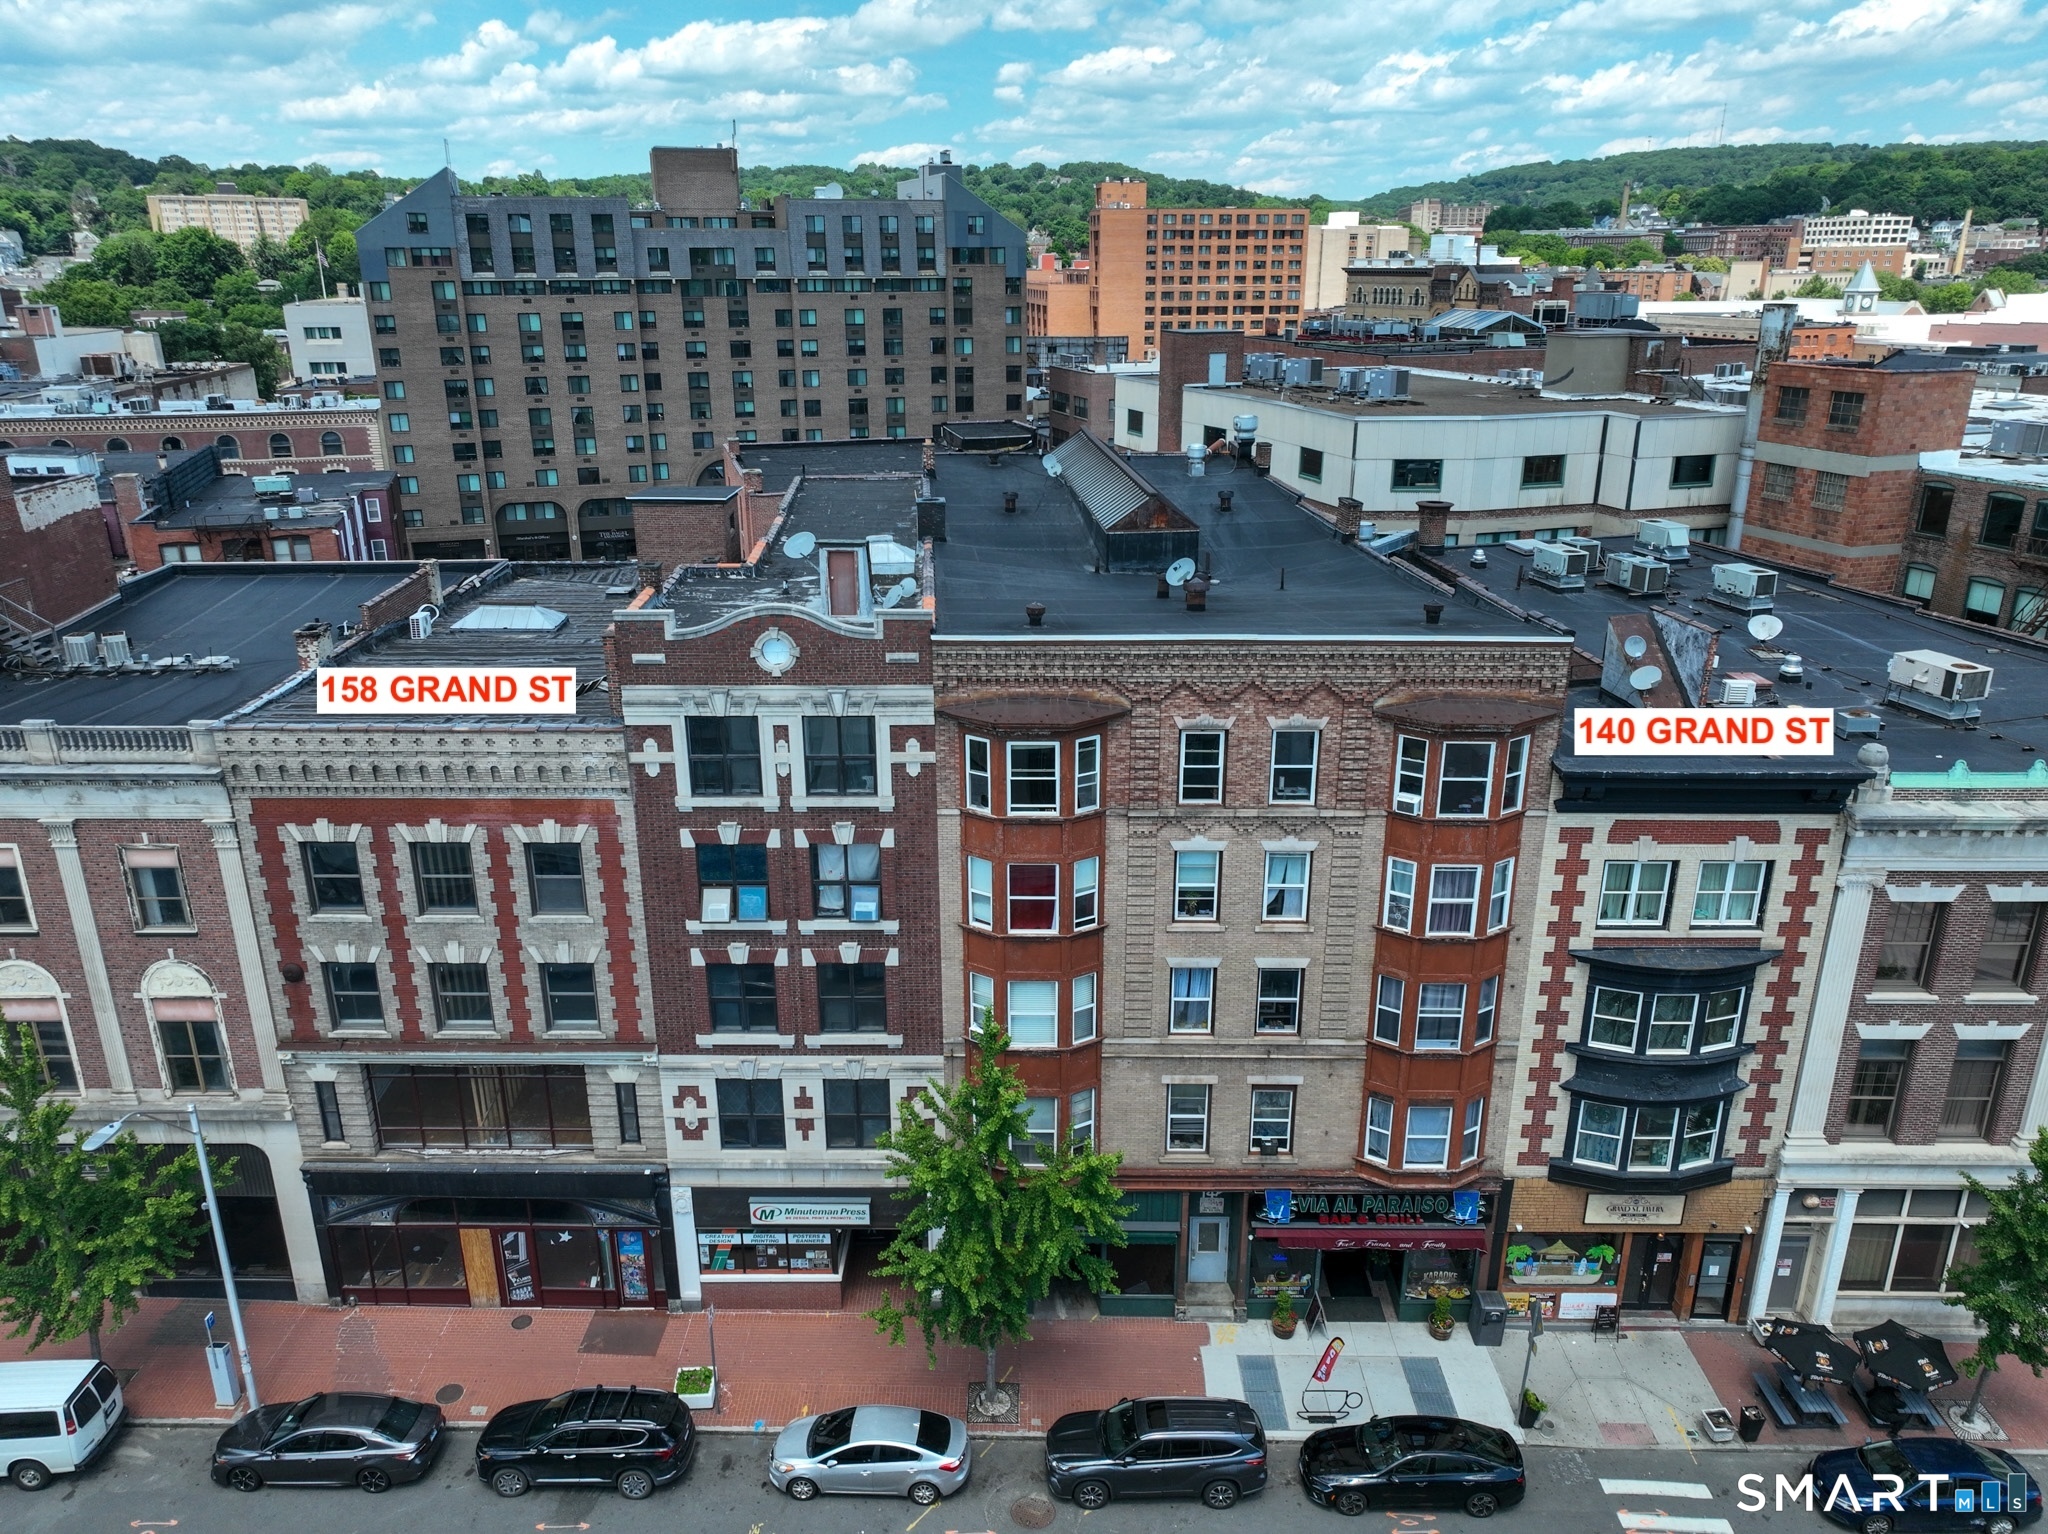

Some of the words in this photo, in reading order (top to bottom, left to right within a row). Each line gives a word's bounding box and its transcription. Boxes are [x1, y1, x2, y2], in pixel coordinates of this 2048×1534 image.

[1297, 1195, 1330, 1213] VIA
[1333, 1195, 1357, 1213] AL
[1362, 1194, 1449, 1214] PARAISO
[784, 1207, 839, 1215] Minuteman
[840, 1207, 866, 1215] Press
[1606, 1205, 1631, 1213] GRAND
[1318, 1214, 1351, 1225] BAR
[1357, 1214, 1369, 1225] &
[1376, 1214, 1424, 1225] GRILL
[1423, 1271, 1459, 1280] KARAOKE
